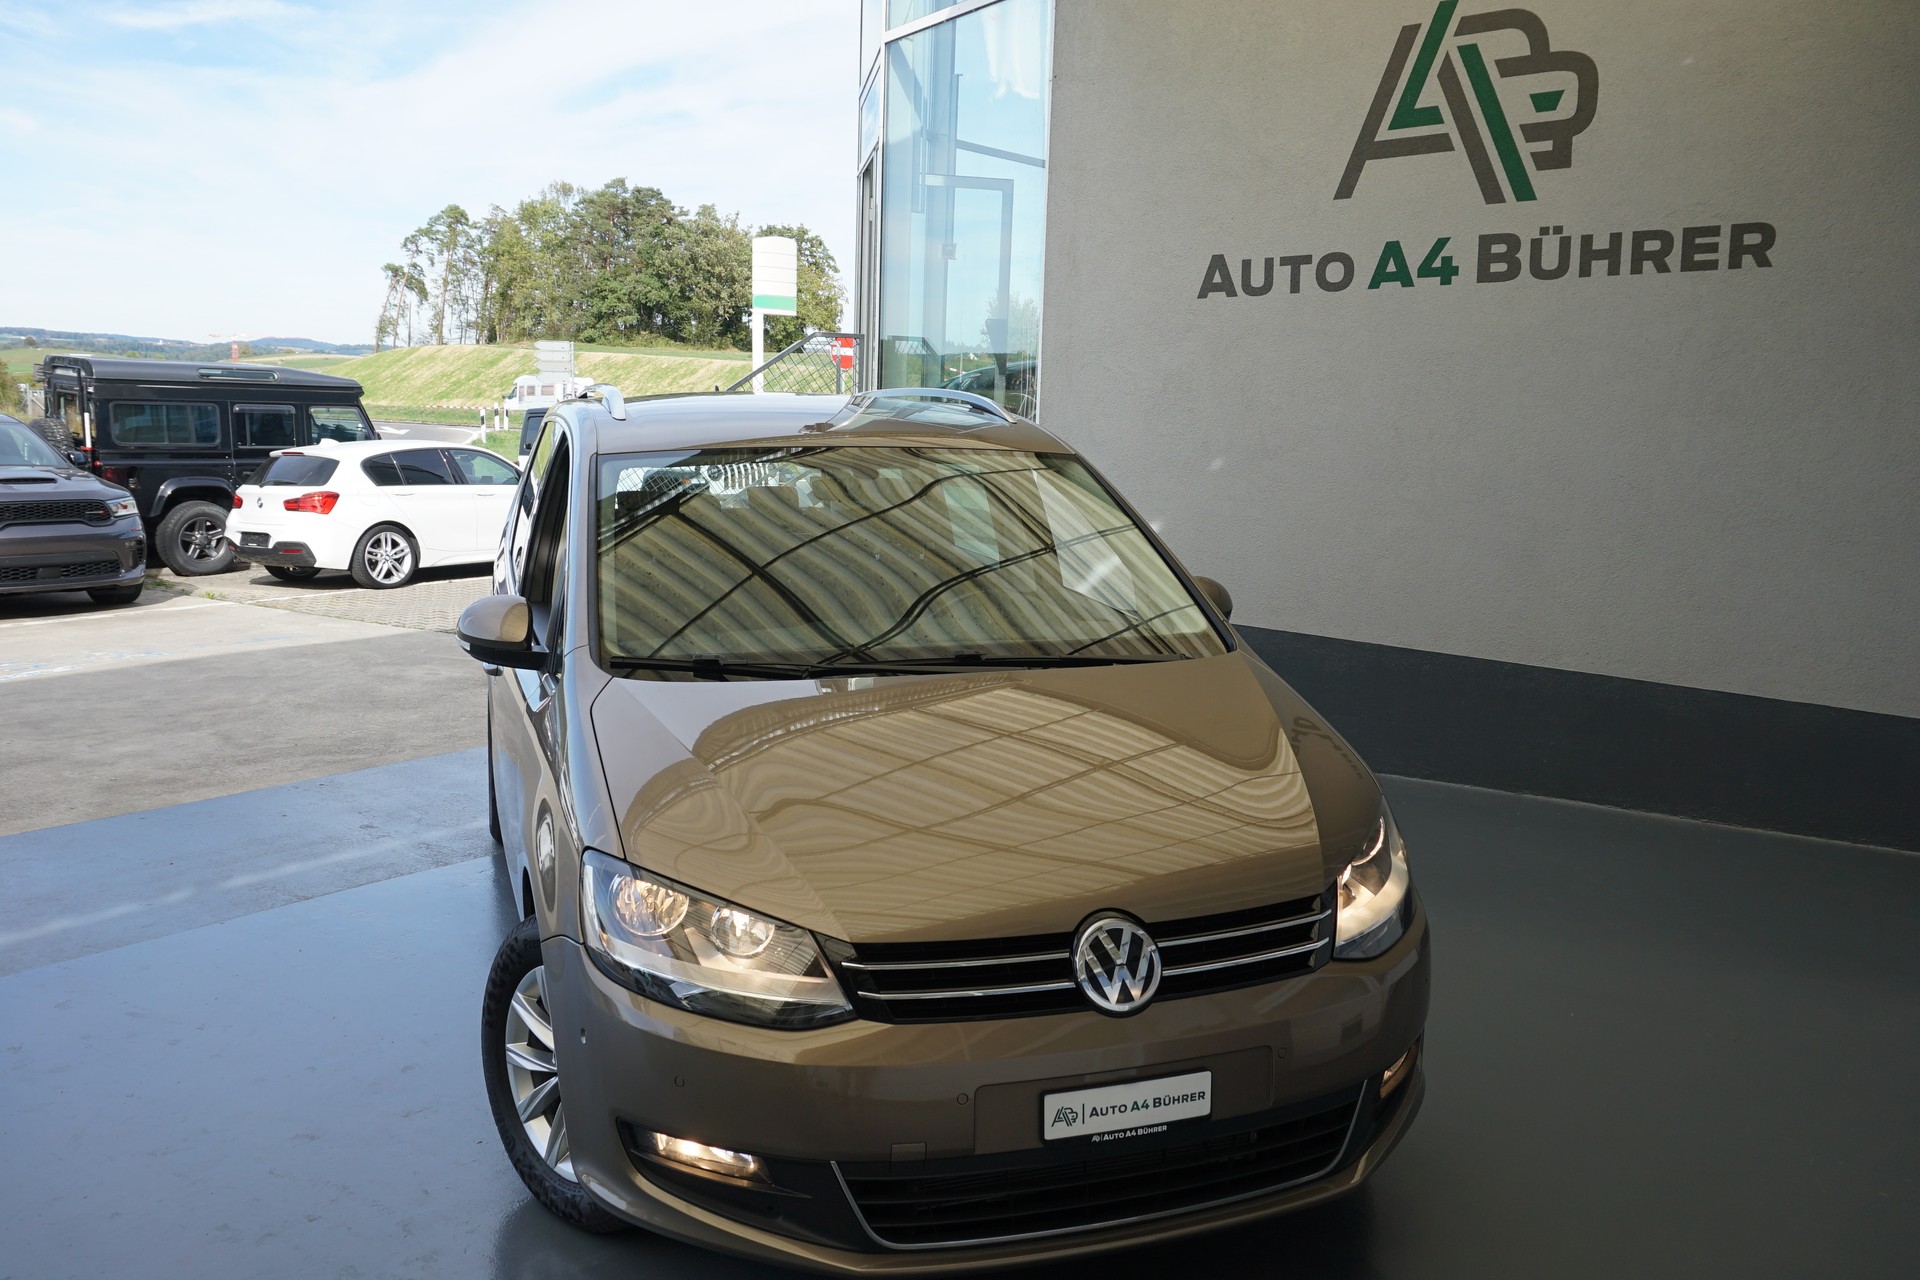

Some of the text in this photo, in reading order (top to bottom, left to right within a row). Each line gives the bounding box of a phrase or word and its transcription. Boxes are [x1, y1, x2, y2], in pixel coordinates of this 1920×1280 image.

[1197, 221, 1777, 300] AUTO A4 BÜHRER
[1089, 1104, 1128, 1119] AUTO
[1130, 1099, 1150, 1113] A4
[1152, 1091, 1206, 1108] BÜHRER
[1102, 1132, 1125, 1142] AUTO
[1125, 1130, 1137, 1138] A4
[1137, 1125, 1168, 1136] BÜHRER
